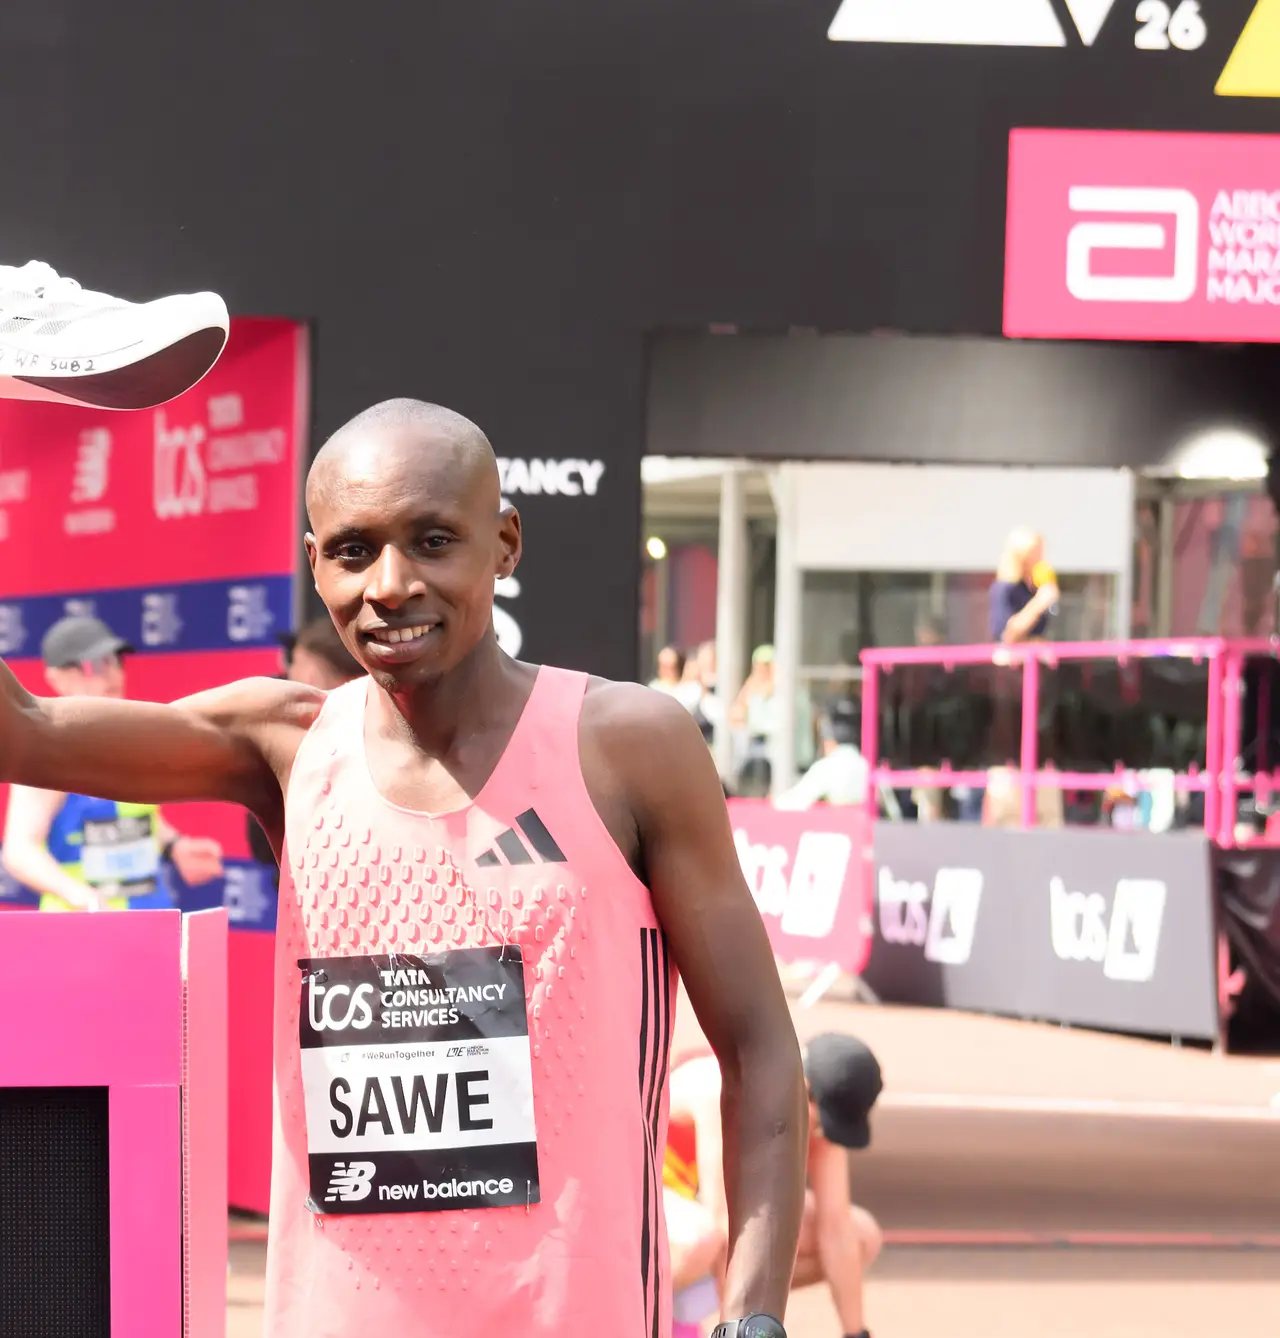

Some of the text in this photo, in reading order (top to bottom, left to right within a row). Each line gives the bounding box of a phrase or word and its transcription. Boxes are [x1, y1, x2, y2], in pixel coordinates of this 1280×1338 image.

[1135, 0, 1207, 50] 26
[380, 969, 431, 987] TATA
[308, 974, 374, 1031] tcs
[380, 983, 507, 1008] CONSULTANCY
[381, 1007, 459, 1029] SERVICES
[329, 1070, 494, 1138] SAWE
[378, 1182, 419, 1201] new
[423, 1177, 514, 1199] balance
